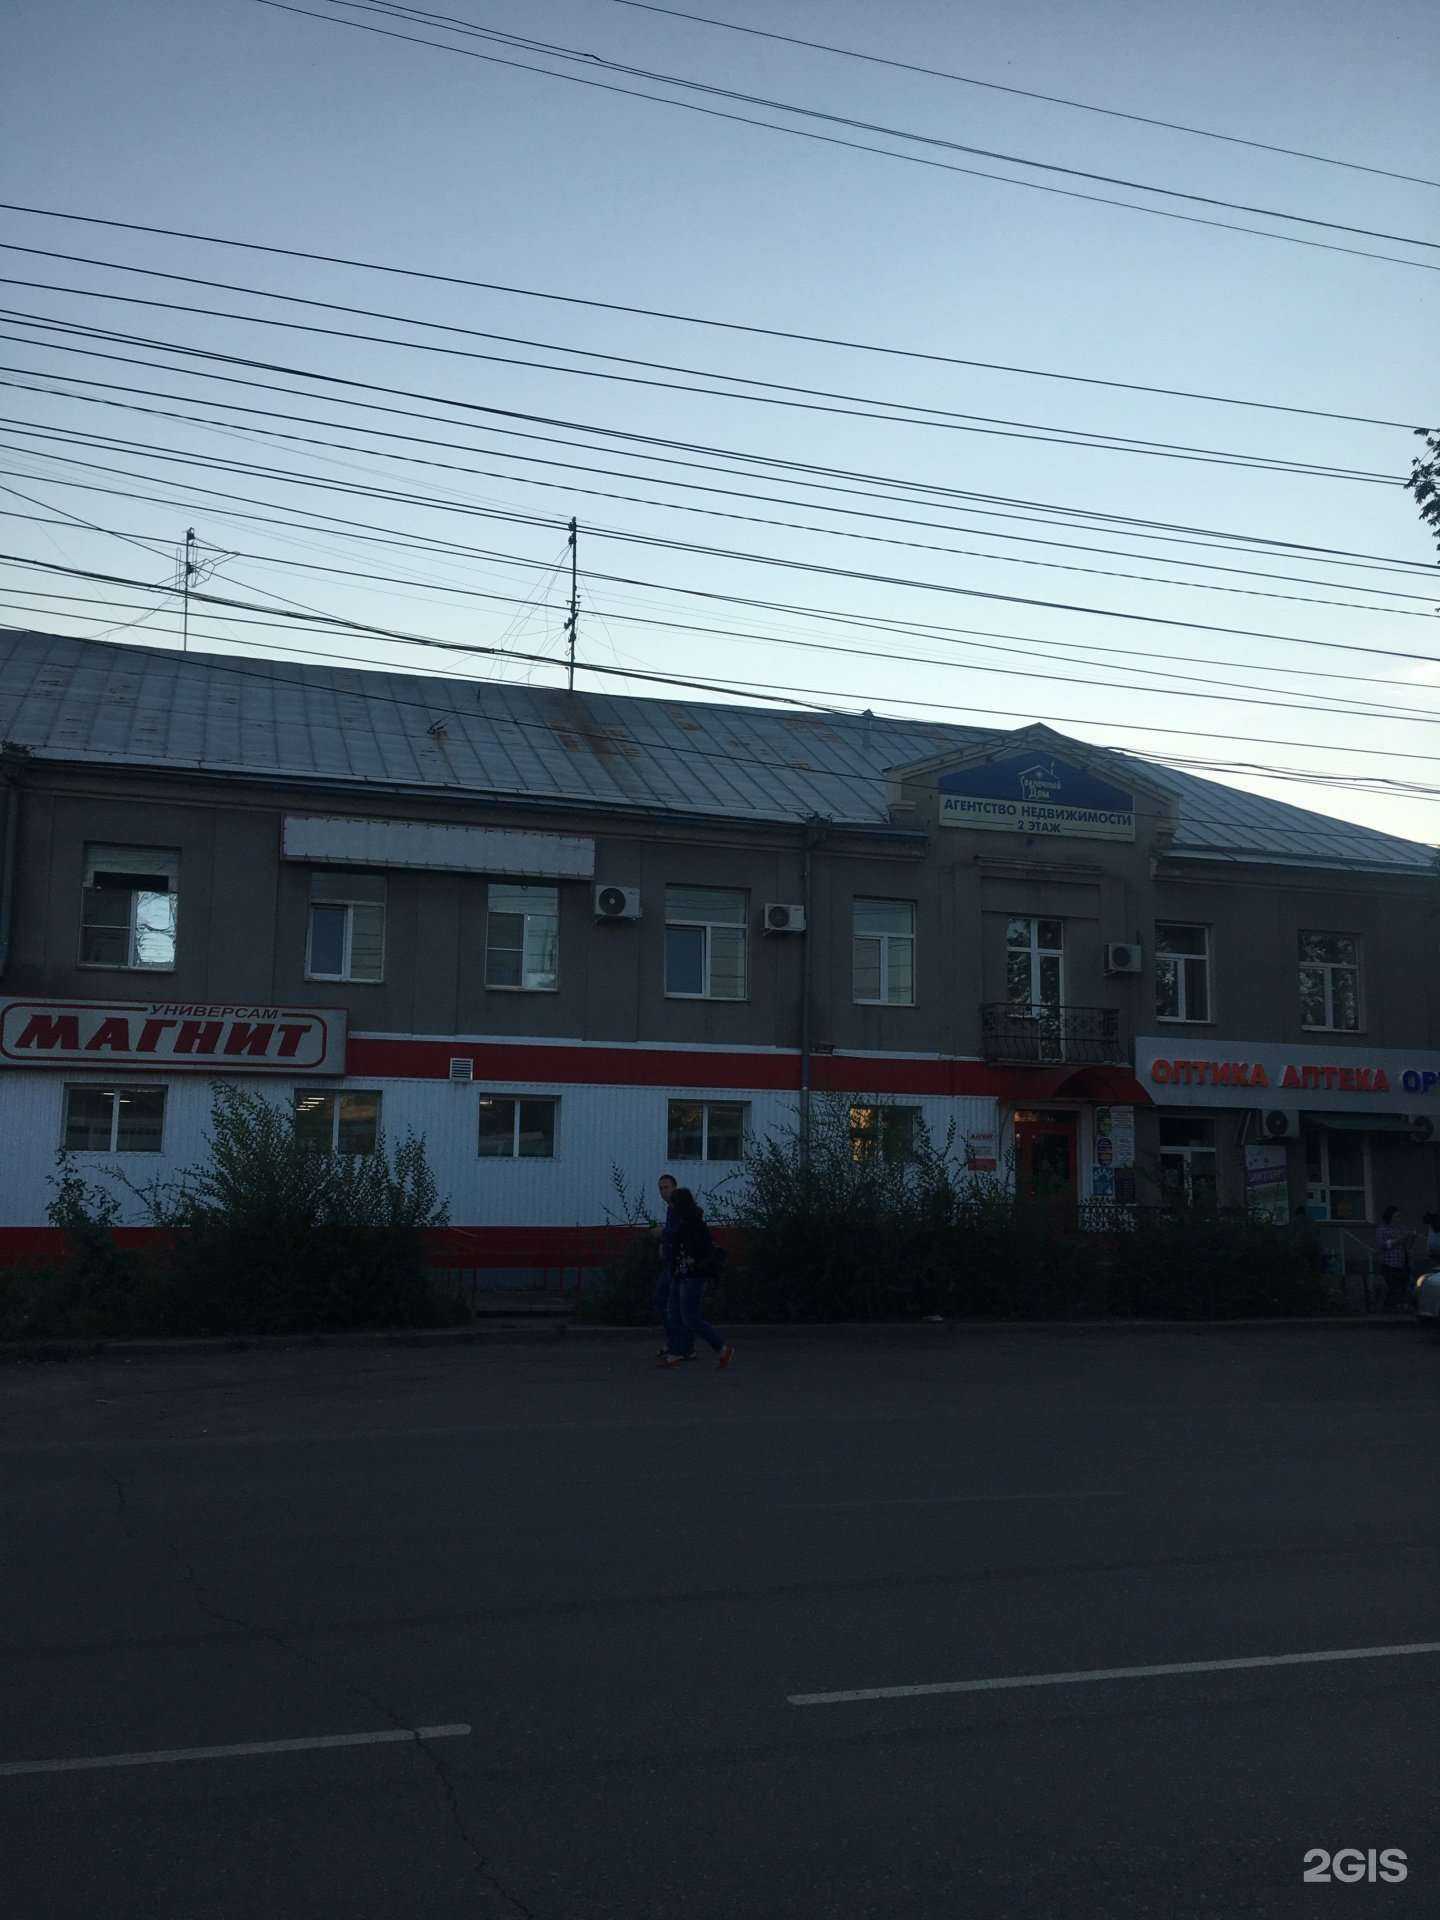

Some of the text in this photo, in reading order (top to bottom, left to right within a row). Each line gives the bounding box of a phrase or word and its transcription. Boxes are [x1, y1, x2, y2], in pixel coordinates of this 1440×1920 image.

[944, 799, 1132, 826] АГЕНТСТВО НЕДВИЖИМОСТИ
[1017, 821, 1061, 833] 2 ЭТАЖ
[149, 1004, 279, 1020] УНИВЕРСАМ
[14, 1014, 313, 1057] МАГНИТ
[1152, 1059, 1270, 1088] ОПТИКА
[1280, 1065, 1391, 1092] АПТЕКА
